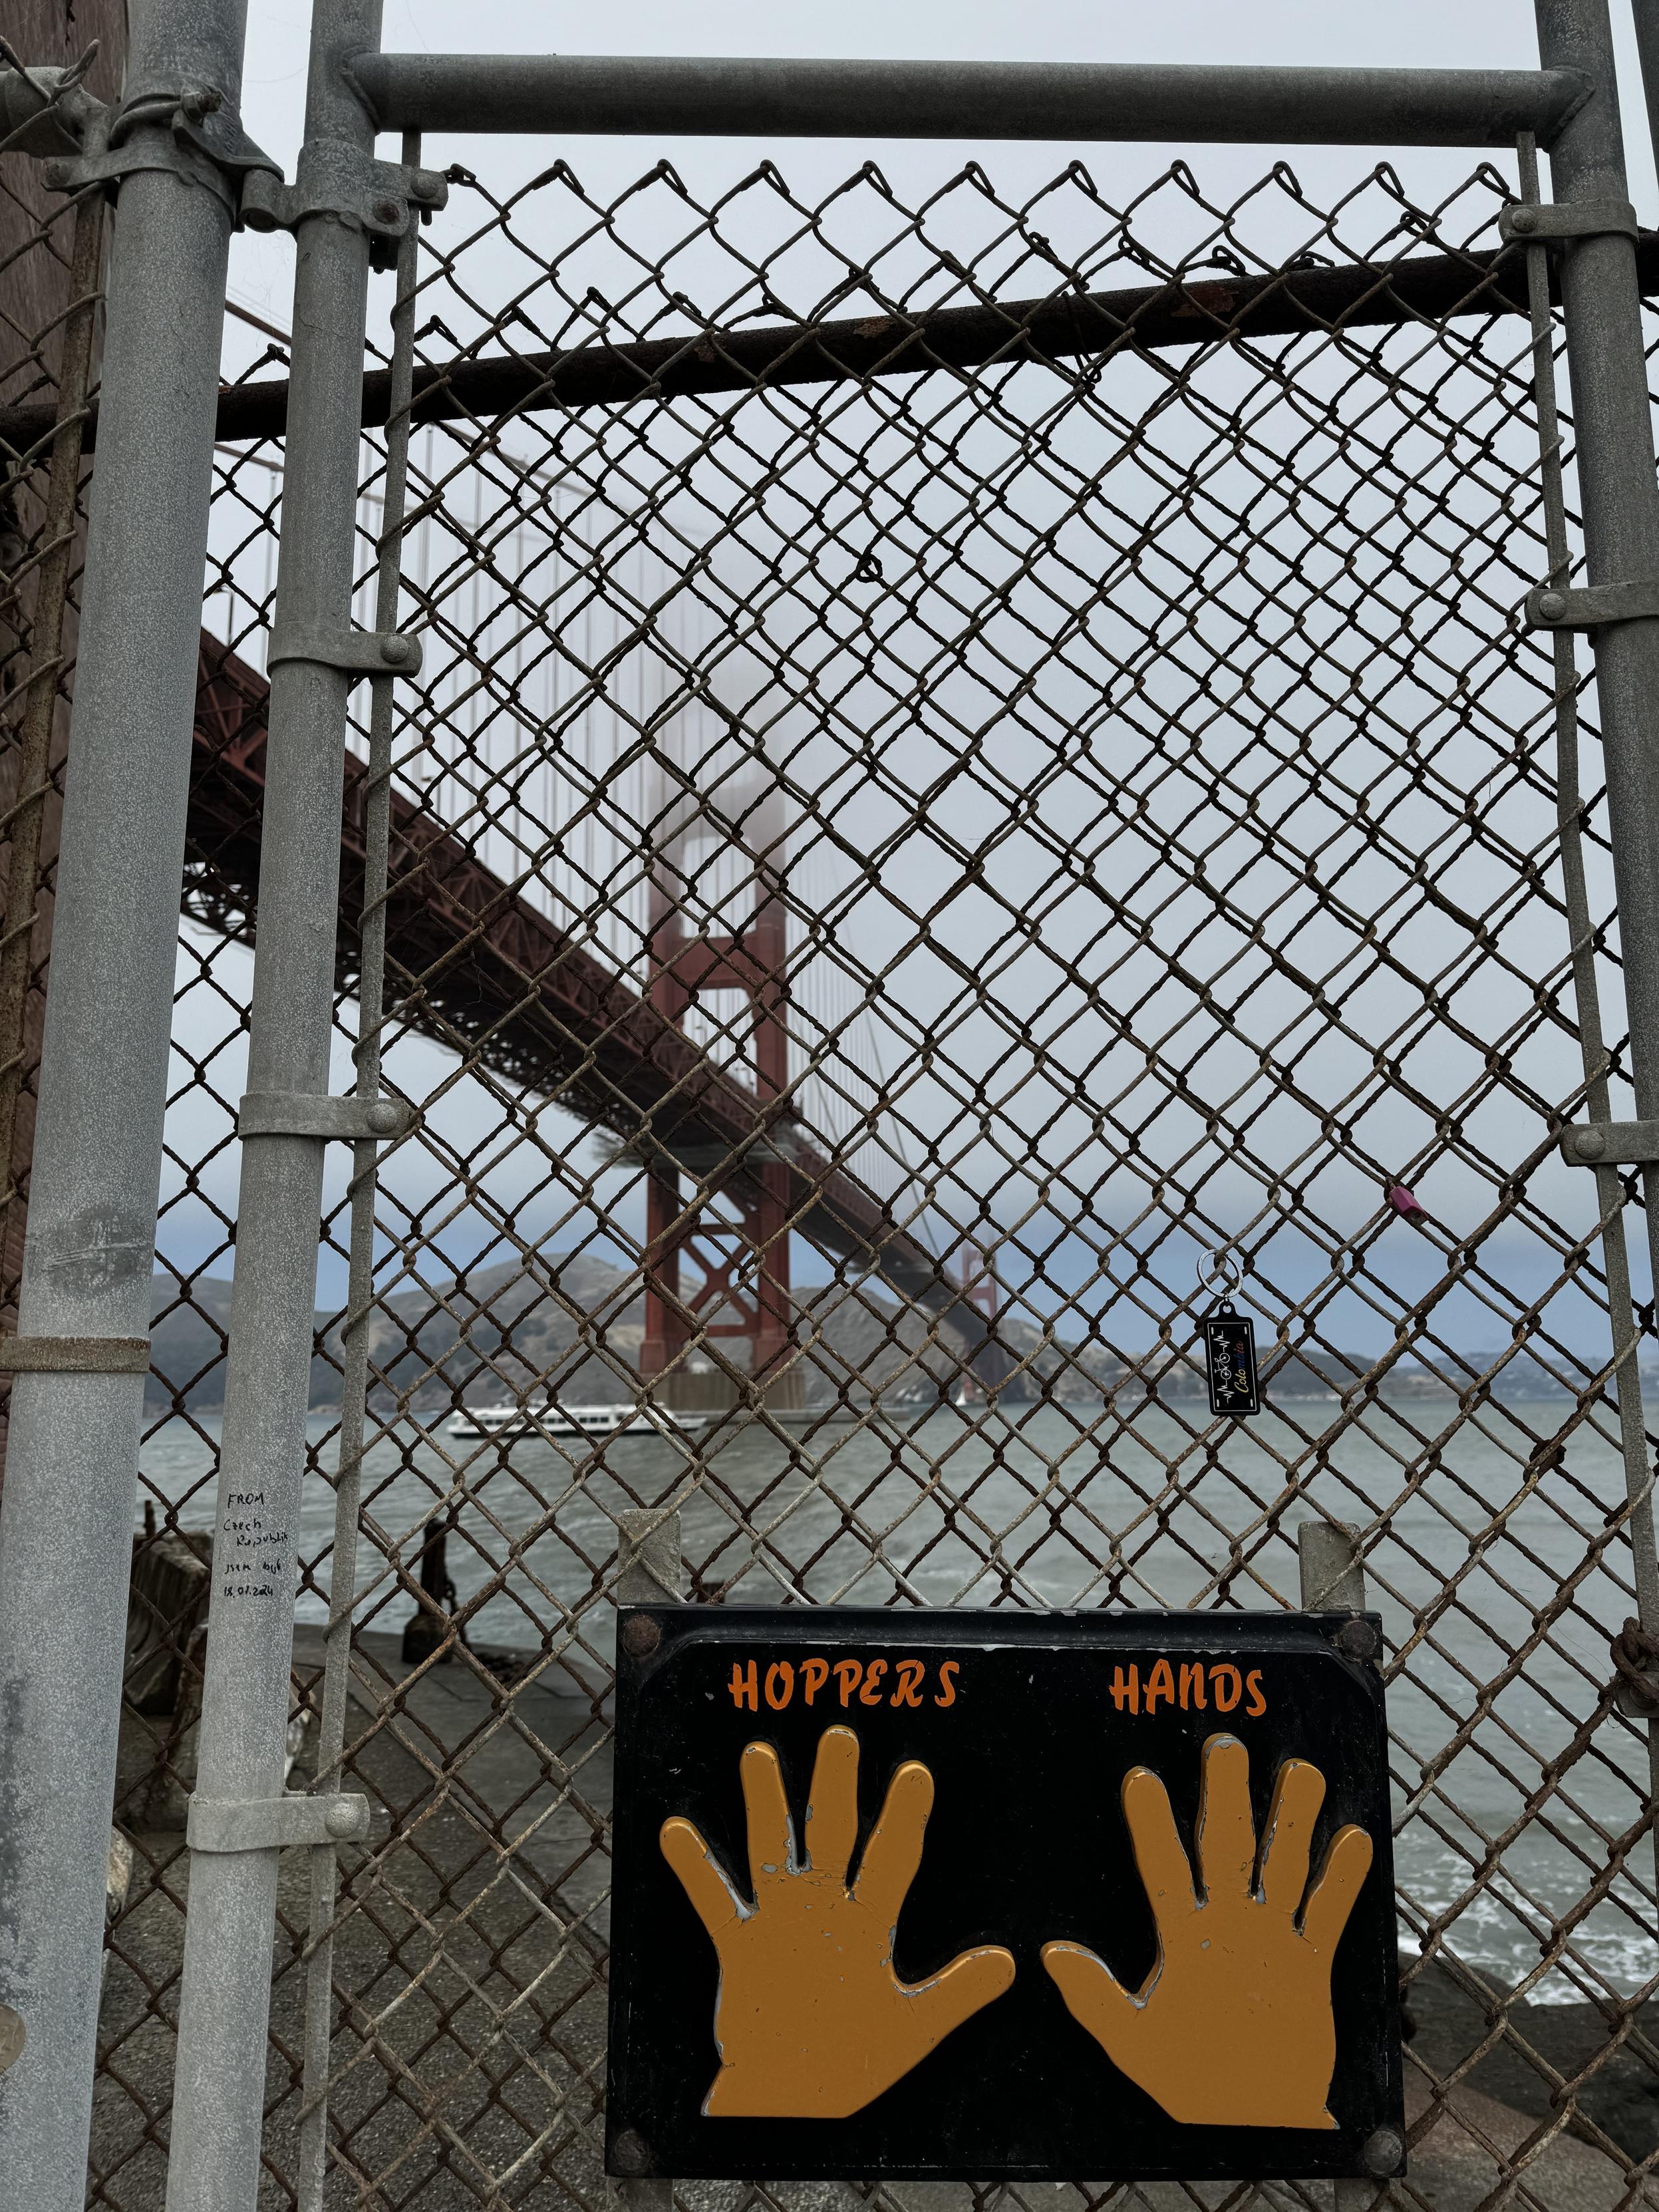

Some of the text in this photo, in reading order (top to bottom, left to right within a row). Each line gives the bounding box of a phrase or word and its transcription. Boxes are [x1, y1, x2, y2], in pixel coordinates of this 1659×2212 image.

[1234, 1341, 1249, 1393] Colombia
[227, 1492, 264, 1508] FROM
[224, 1519, 261, 1531] Czech
[728, 1658, 1267, 1716] HOPPERS HANDS
